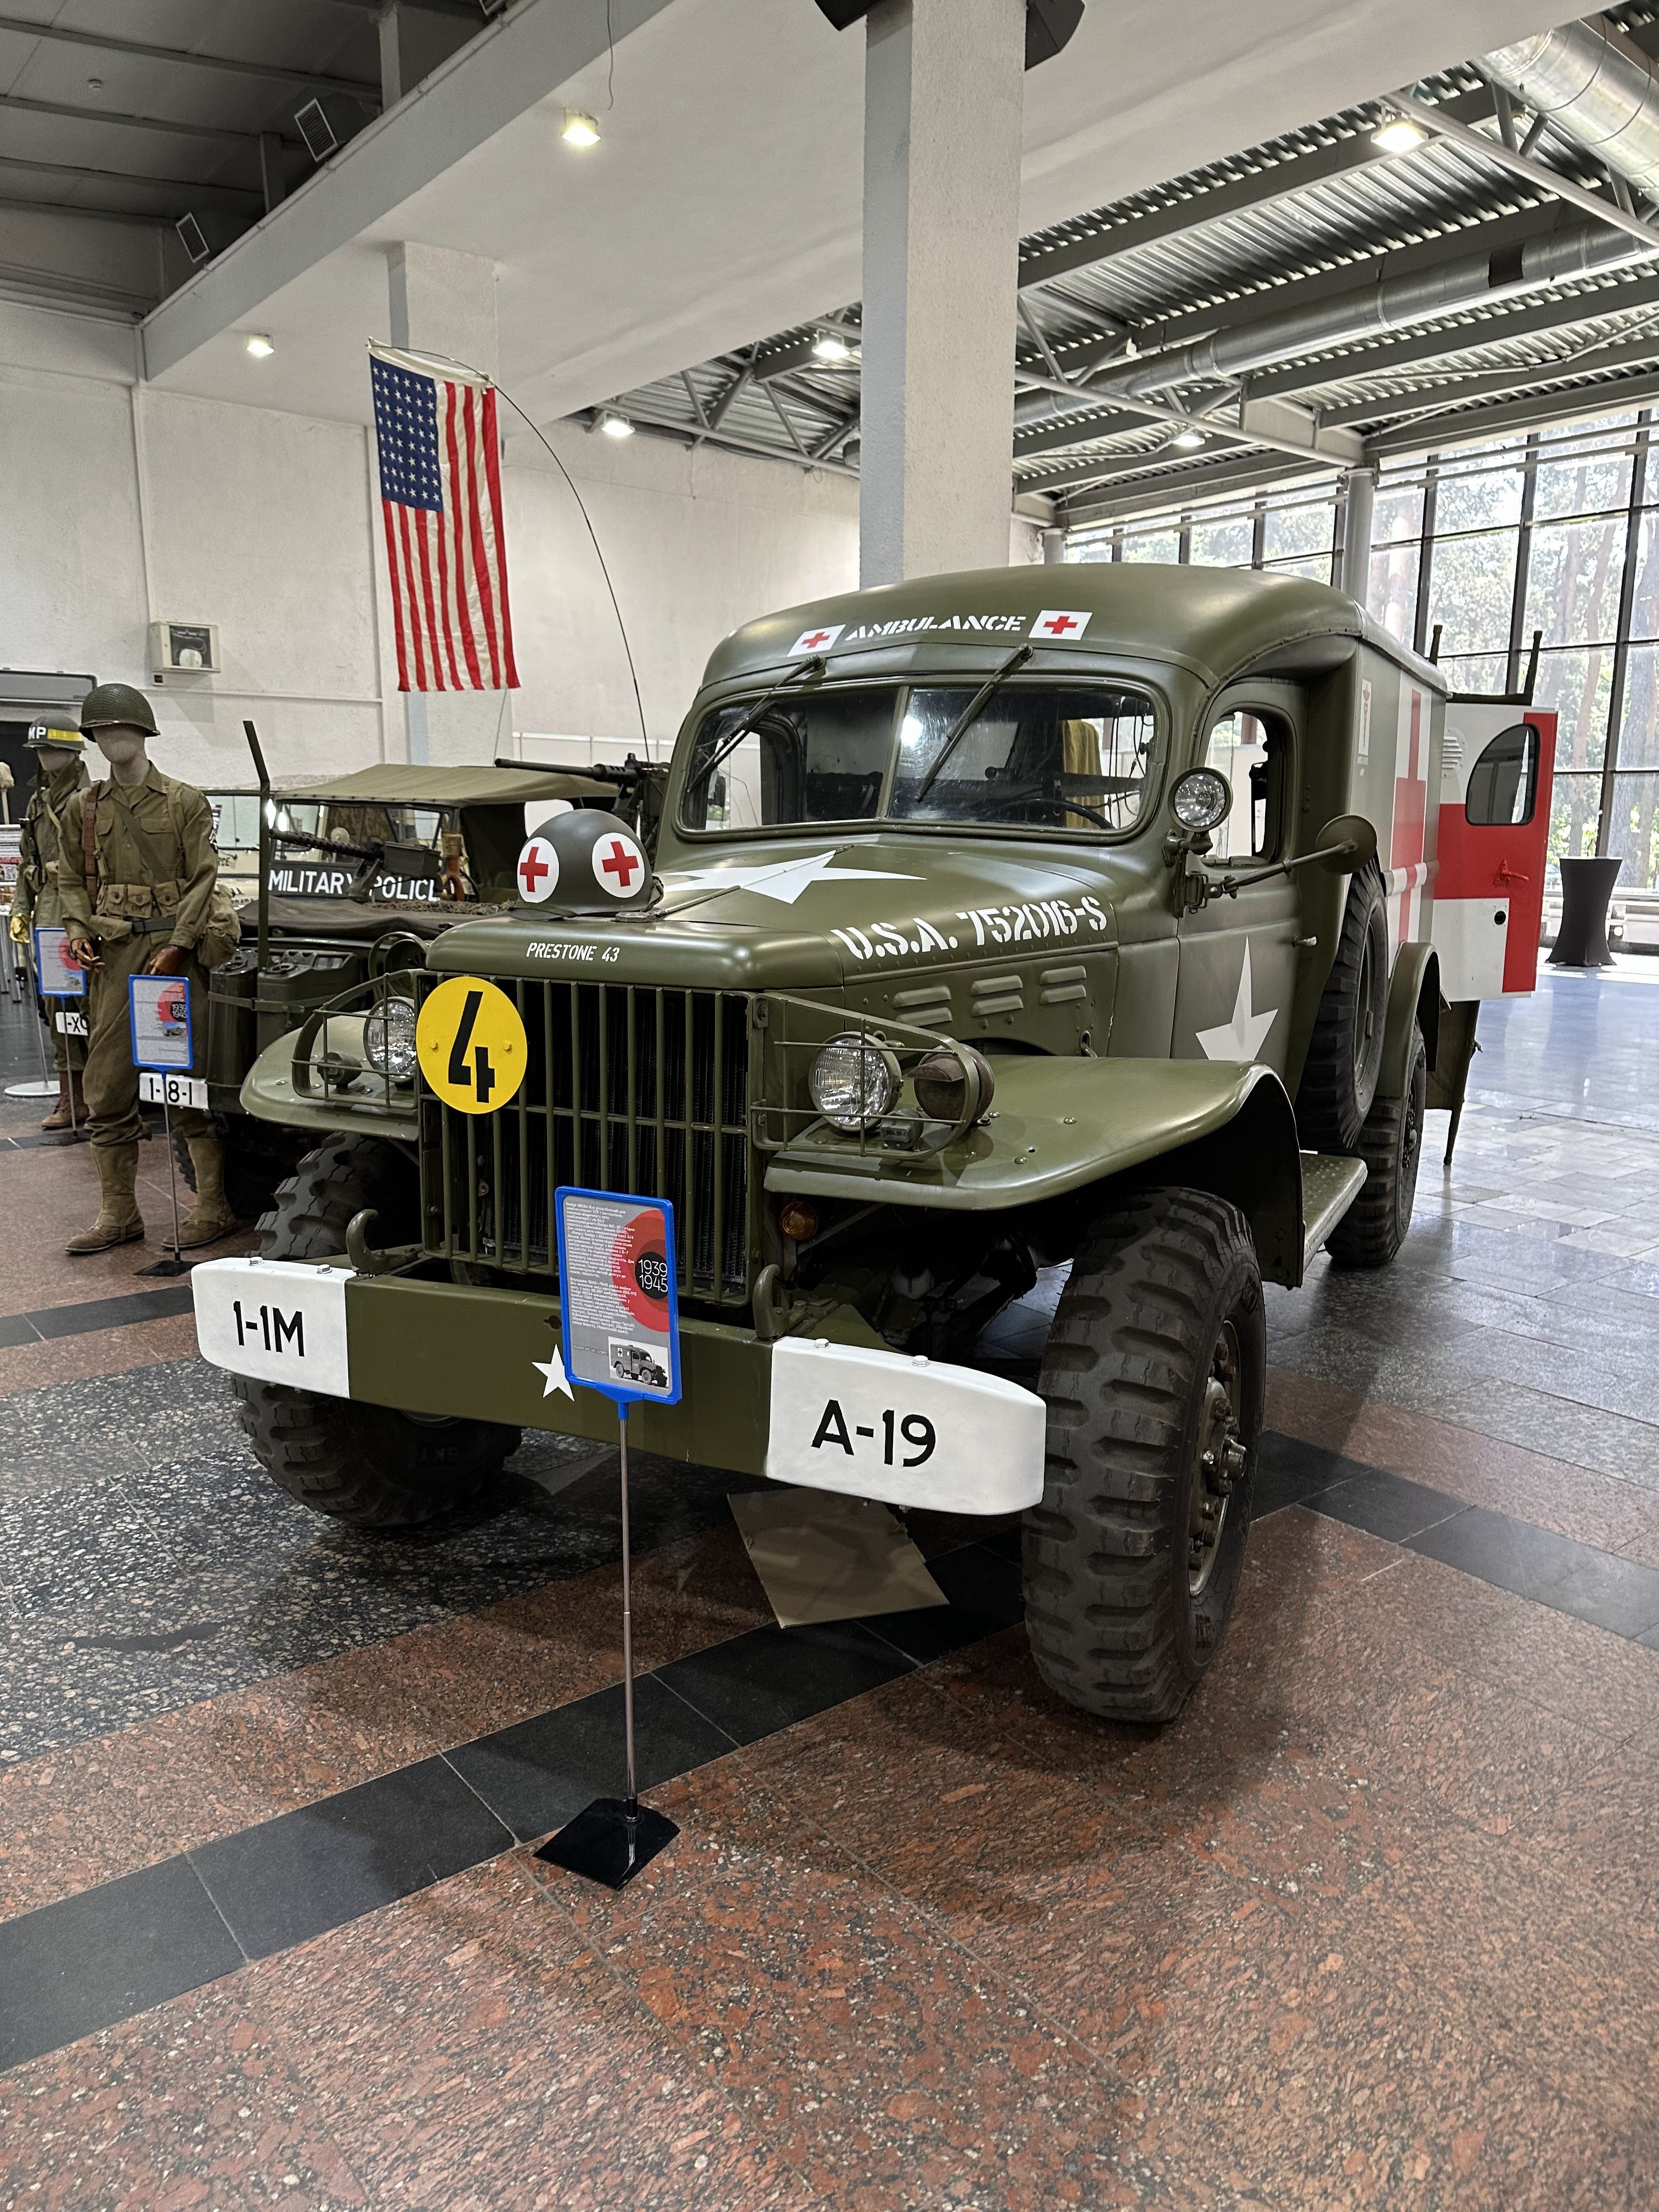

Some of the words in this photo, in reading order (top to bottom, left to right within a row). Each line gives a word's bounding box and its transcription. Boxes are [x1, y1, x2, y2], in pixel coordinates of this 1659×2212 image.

[845, 615, 1026, 641] AMBULANCE
[28, 726, 47, 740] MP
[830, 917, 958, 961] U.S.A.
[955, 896, 1107, 946] 752016-S
[526, 942, 597, 962] PRESTONE
[601, 946, 620, 963] 43
[448, 990, 495, 1103] 4
[150, 1077, 193, 1105] 1-8-1
[638, 1259, 668, 1278] 1939
[639, 1274, 668, 1293] 1945
[233, 1300, 305, 1357] 1-1M
[811, 1398, 936, 1467] A-19
